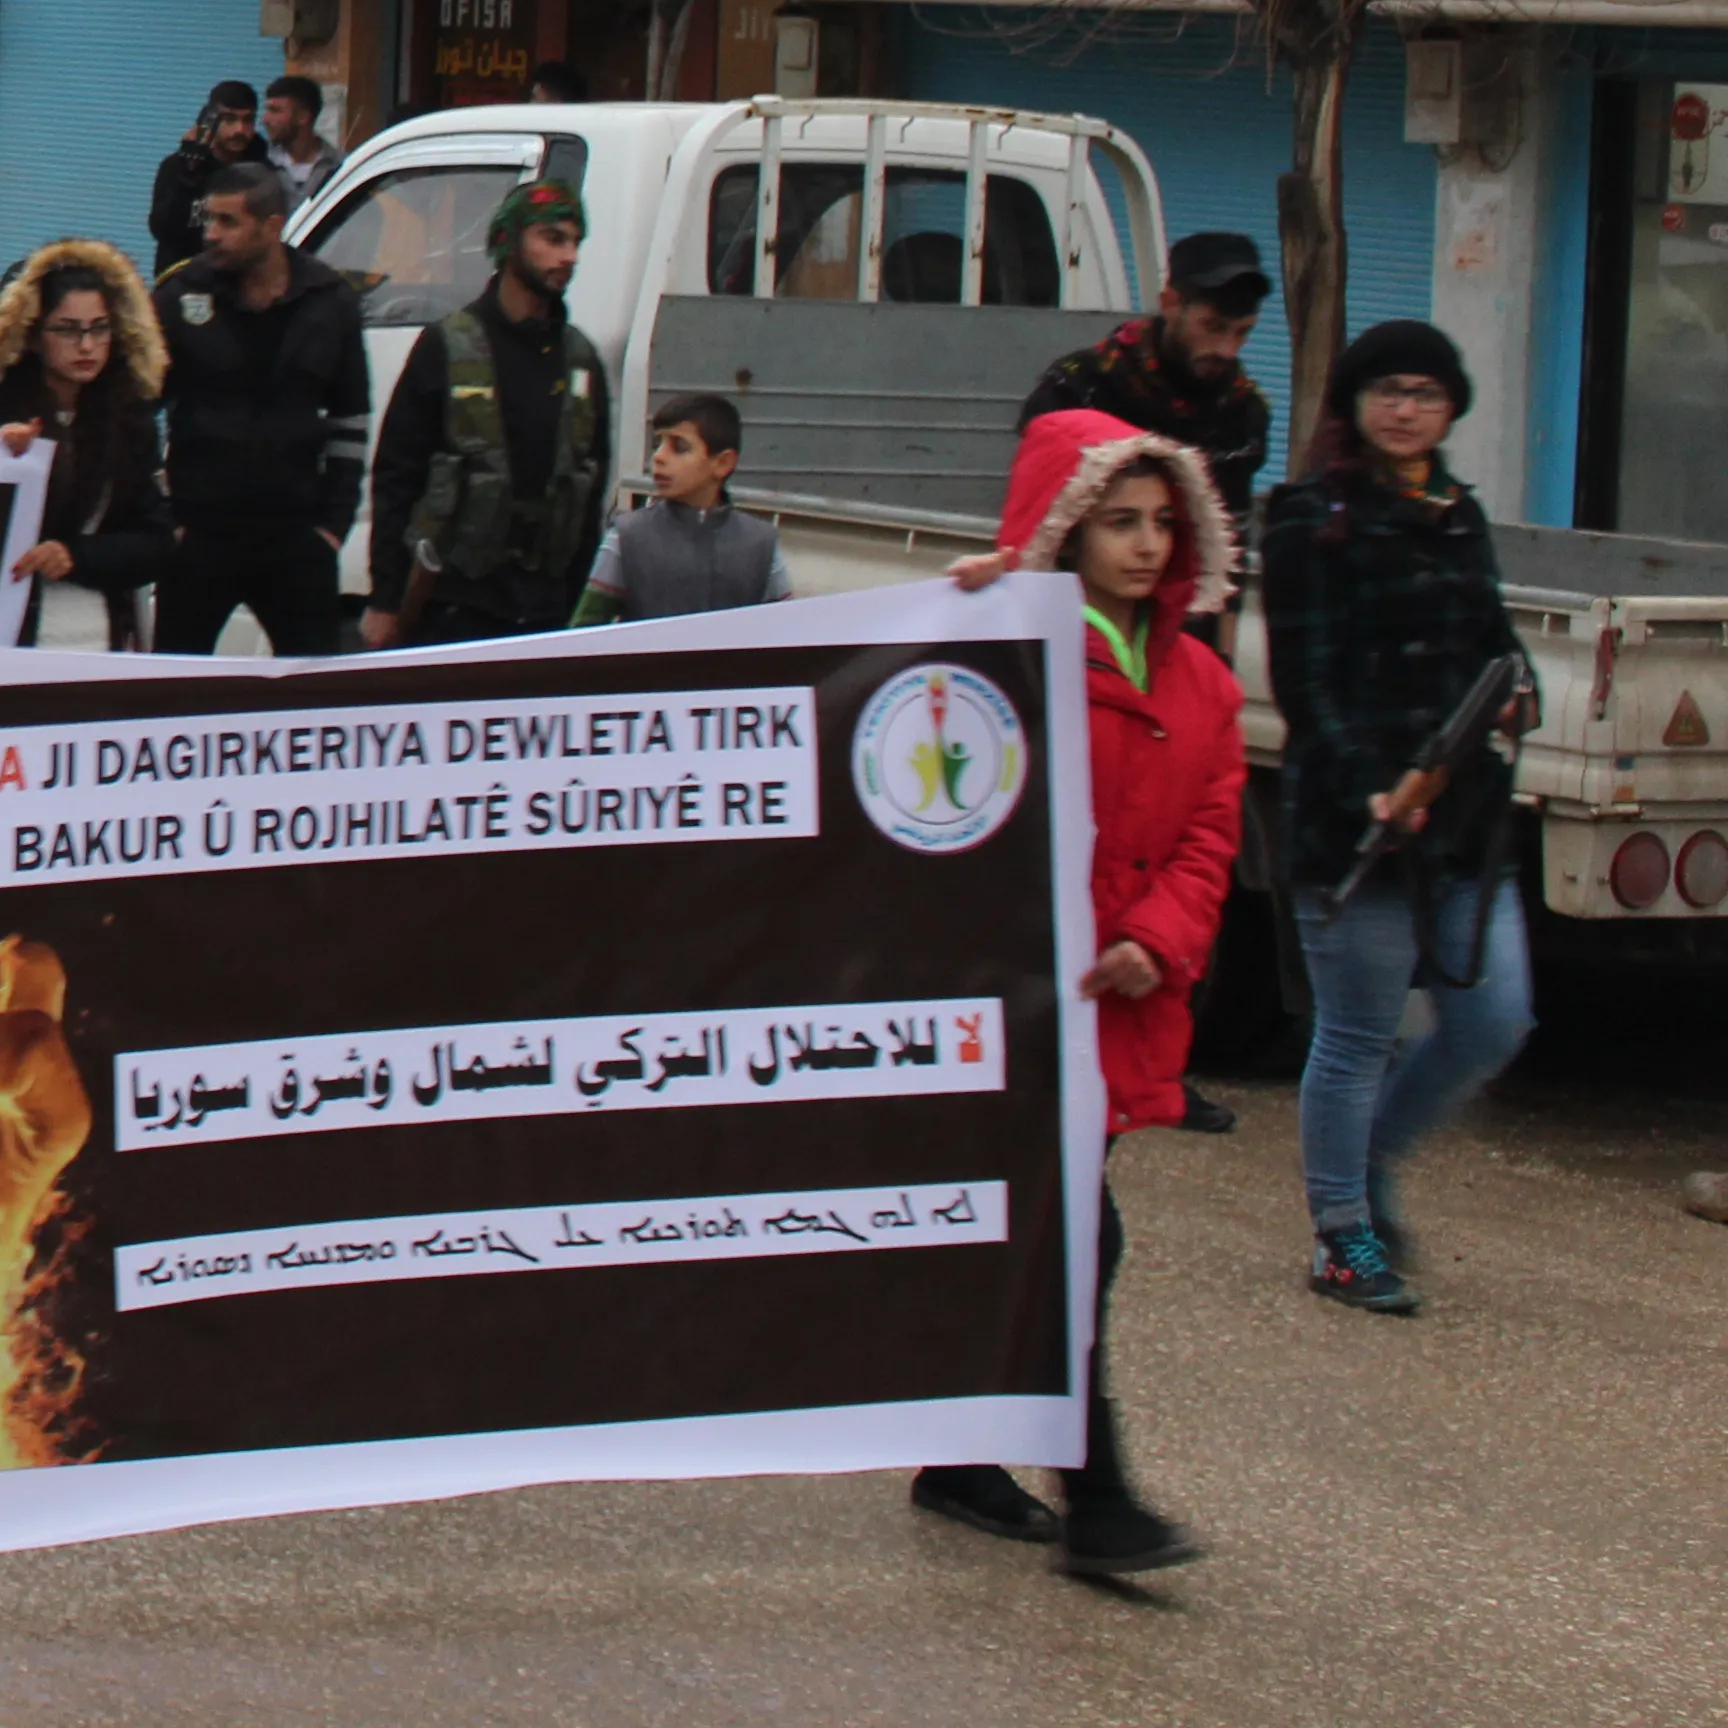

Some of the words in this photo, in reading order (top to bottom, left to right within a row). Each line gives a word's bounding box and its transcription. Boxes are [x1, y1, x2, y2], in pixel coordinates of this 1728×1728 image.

[41, 741, 79, 791] JI
[96, 720, 428, 787] DAGIRKERIYA
[446, 710, 675, 764] DEWLETA
[688, 704, 804, 752] TIRK
[13, 813, 184, 873] BAKUR
[202, 798, 234, 857] Û
[252, 782, 513, 854] ROJHILATÊ
[524, 772, 704, 837] SÛRIYÊ
[720, 780, 789, 827] RE
[411, 1035, 555, 1108] لشمال
[575, 1024, 728, 1108] التركي
[747, 1014, 939, 1088] للاحتلال
[954, 1011, 985, 1064] لا
[130, 1067, 251, 1132] سوريا
[268, 1047, 394, 1121] وشرق
